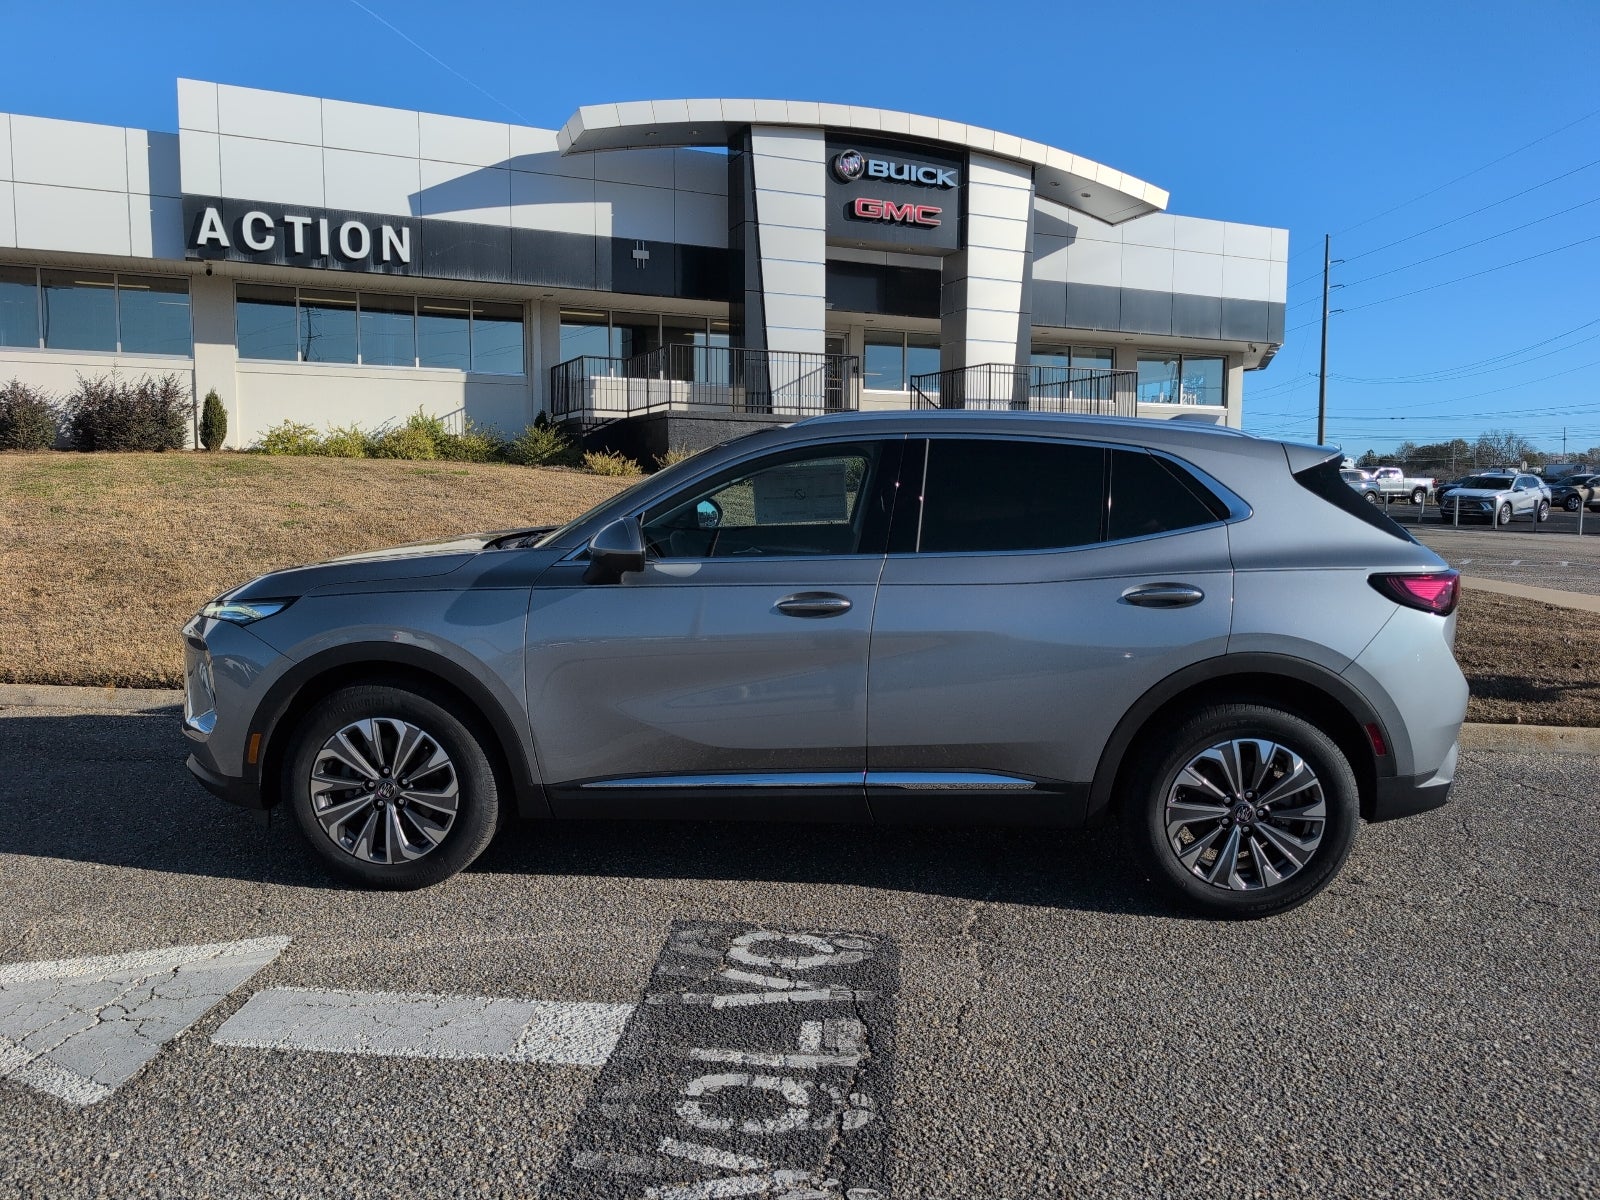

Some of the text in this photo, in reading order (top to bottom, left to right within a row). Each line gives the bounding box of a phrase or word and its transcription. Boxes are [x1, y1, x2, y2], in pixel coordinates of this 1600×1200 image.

[868, 159, 958, 187] BUICK
[855, 197, 942, 225] GMC
[197, 207, 411, 263] ACTION
